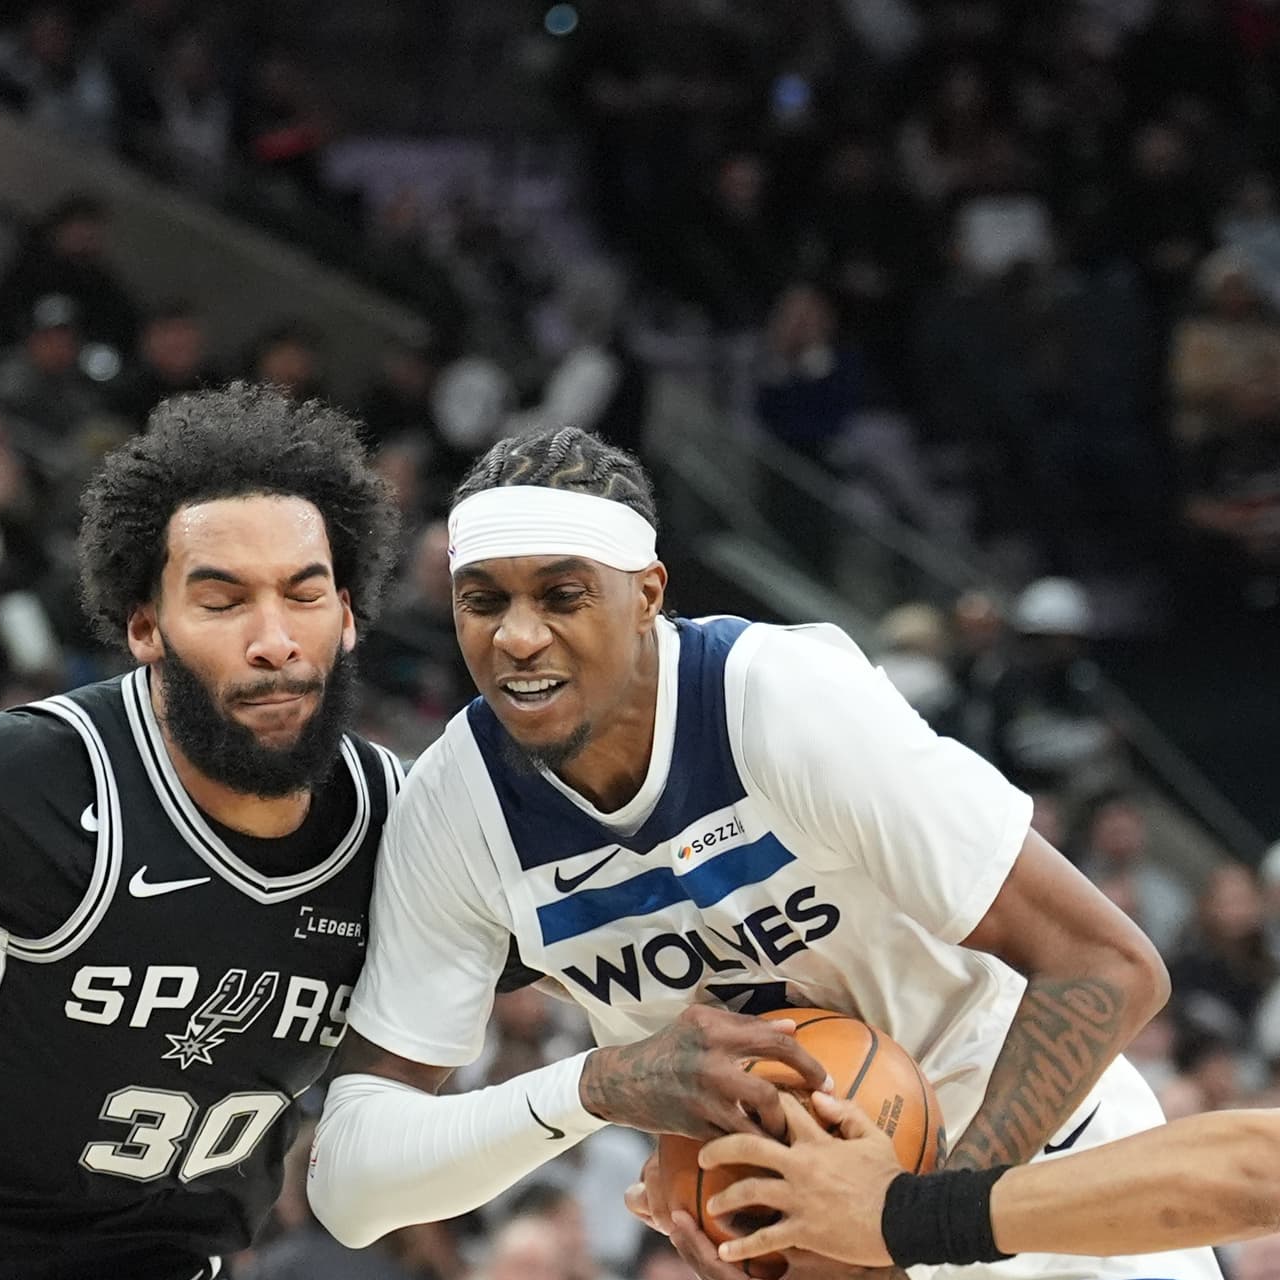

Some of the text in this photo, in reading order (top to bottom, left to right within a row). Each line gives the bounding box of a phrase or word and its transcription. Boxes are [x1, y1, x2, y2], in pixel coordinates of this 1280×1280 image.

[691, 816, 745, 853] sezzl
[307, 916, 362, 937] LEDGER
[561, 885, 840, 1006] WOLVES
[78, 1085, 291, 1184] 30
